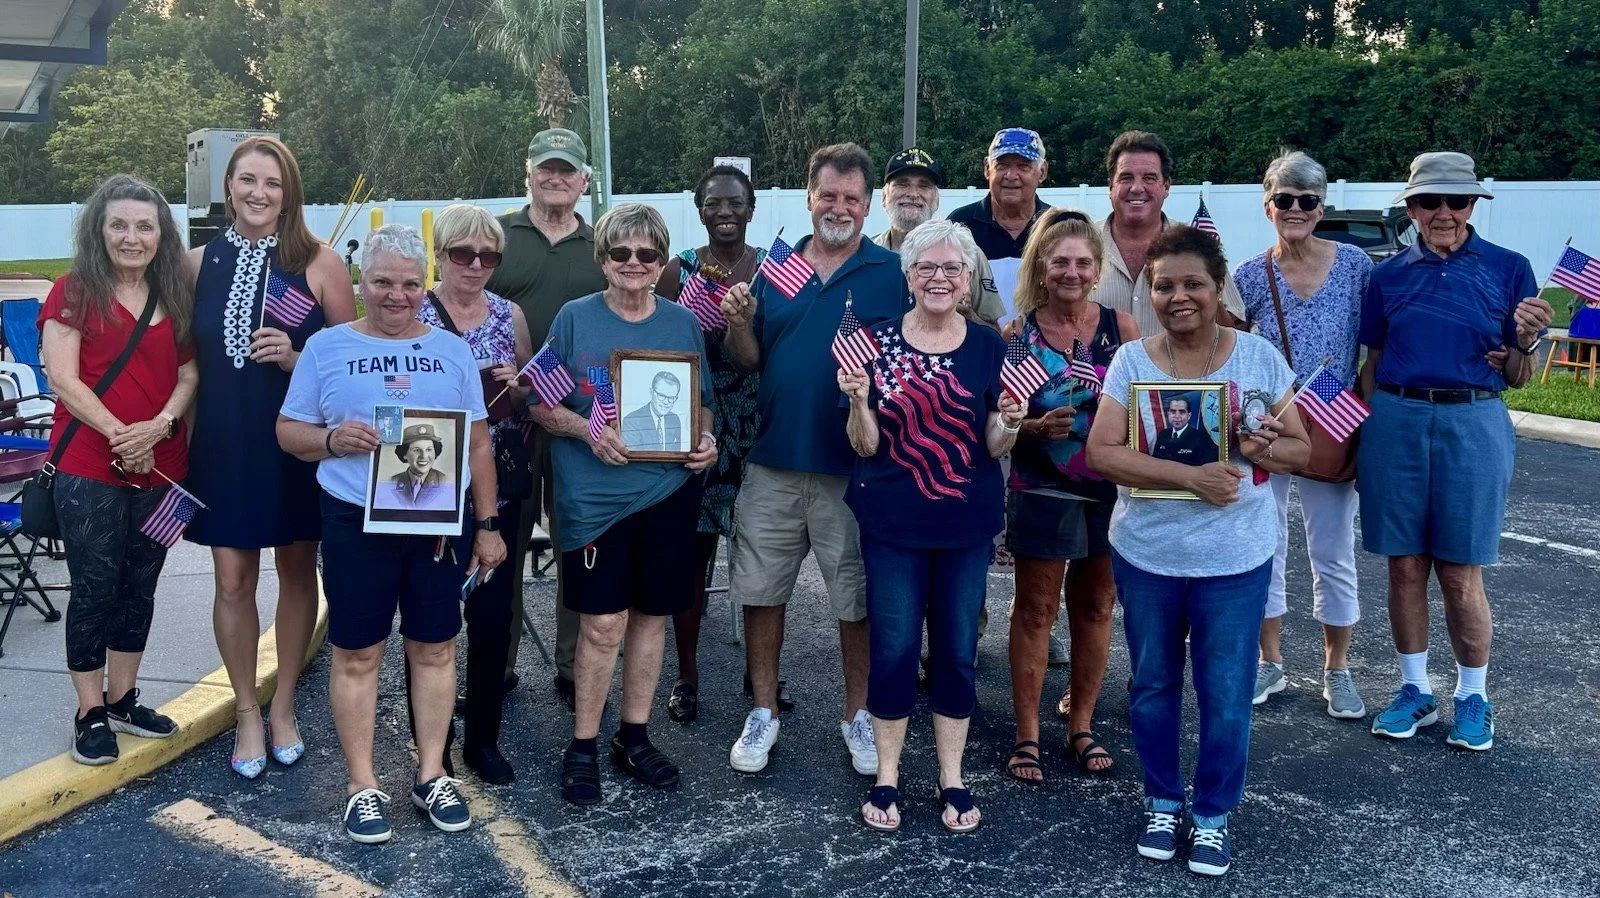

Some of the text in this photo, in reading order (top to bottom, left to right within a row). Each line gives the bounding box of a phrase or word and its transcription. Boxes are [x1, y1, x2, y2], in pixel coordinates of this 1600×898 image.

[905, 160, 928, 168] VETERAN
[919, 149, 935, 164] FORCE
[346, 355, 446, 376] TEAM USA
